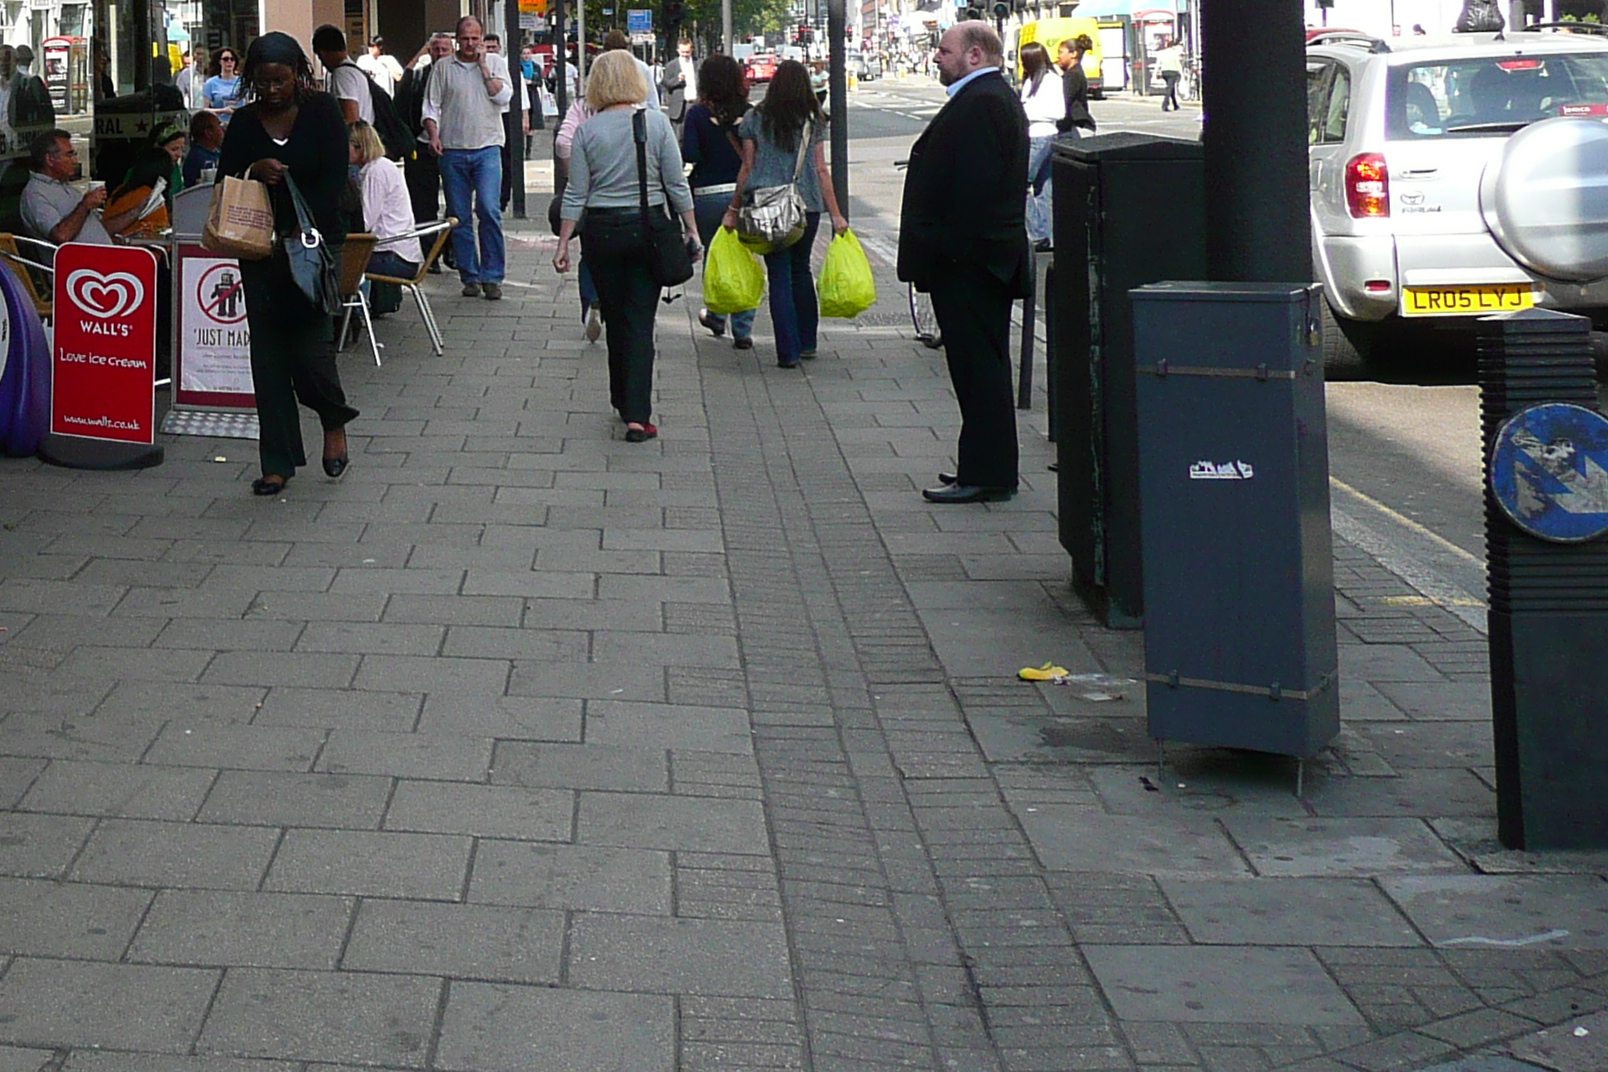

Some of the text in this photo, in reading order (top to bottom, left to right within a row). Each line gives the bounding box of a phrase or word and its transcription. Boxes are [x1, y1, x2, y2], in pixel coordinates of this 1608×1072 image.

[1413, 288, 1522, 309] LR05 LYJ
[80, 319, 130, 337] WALL'S
[59, 346, 86, 365] Love
[89, 353, 107, 366] ice
